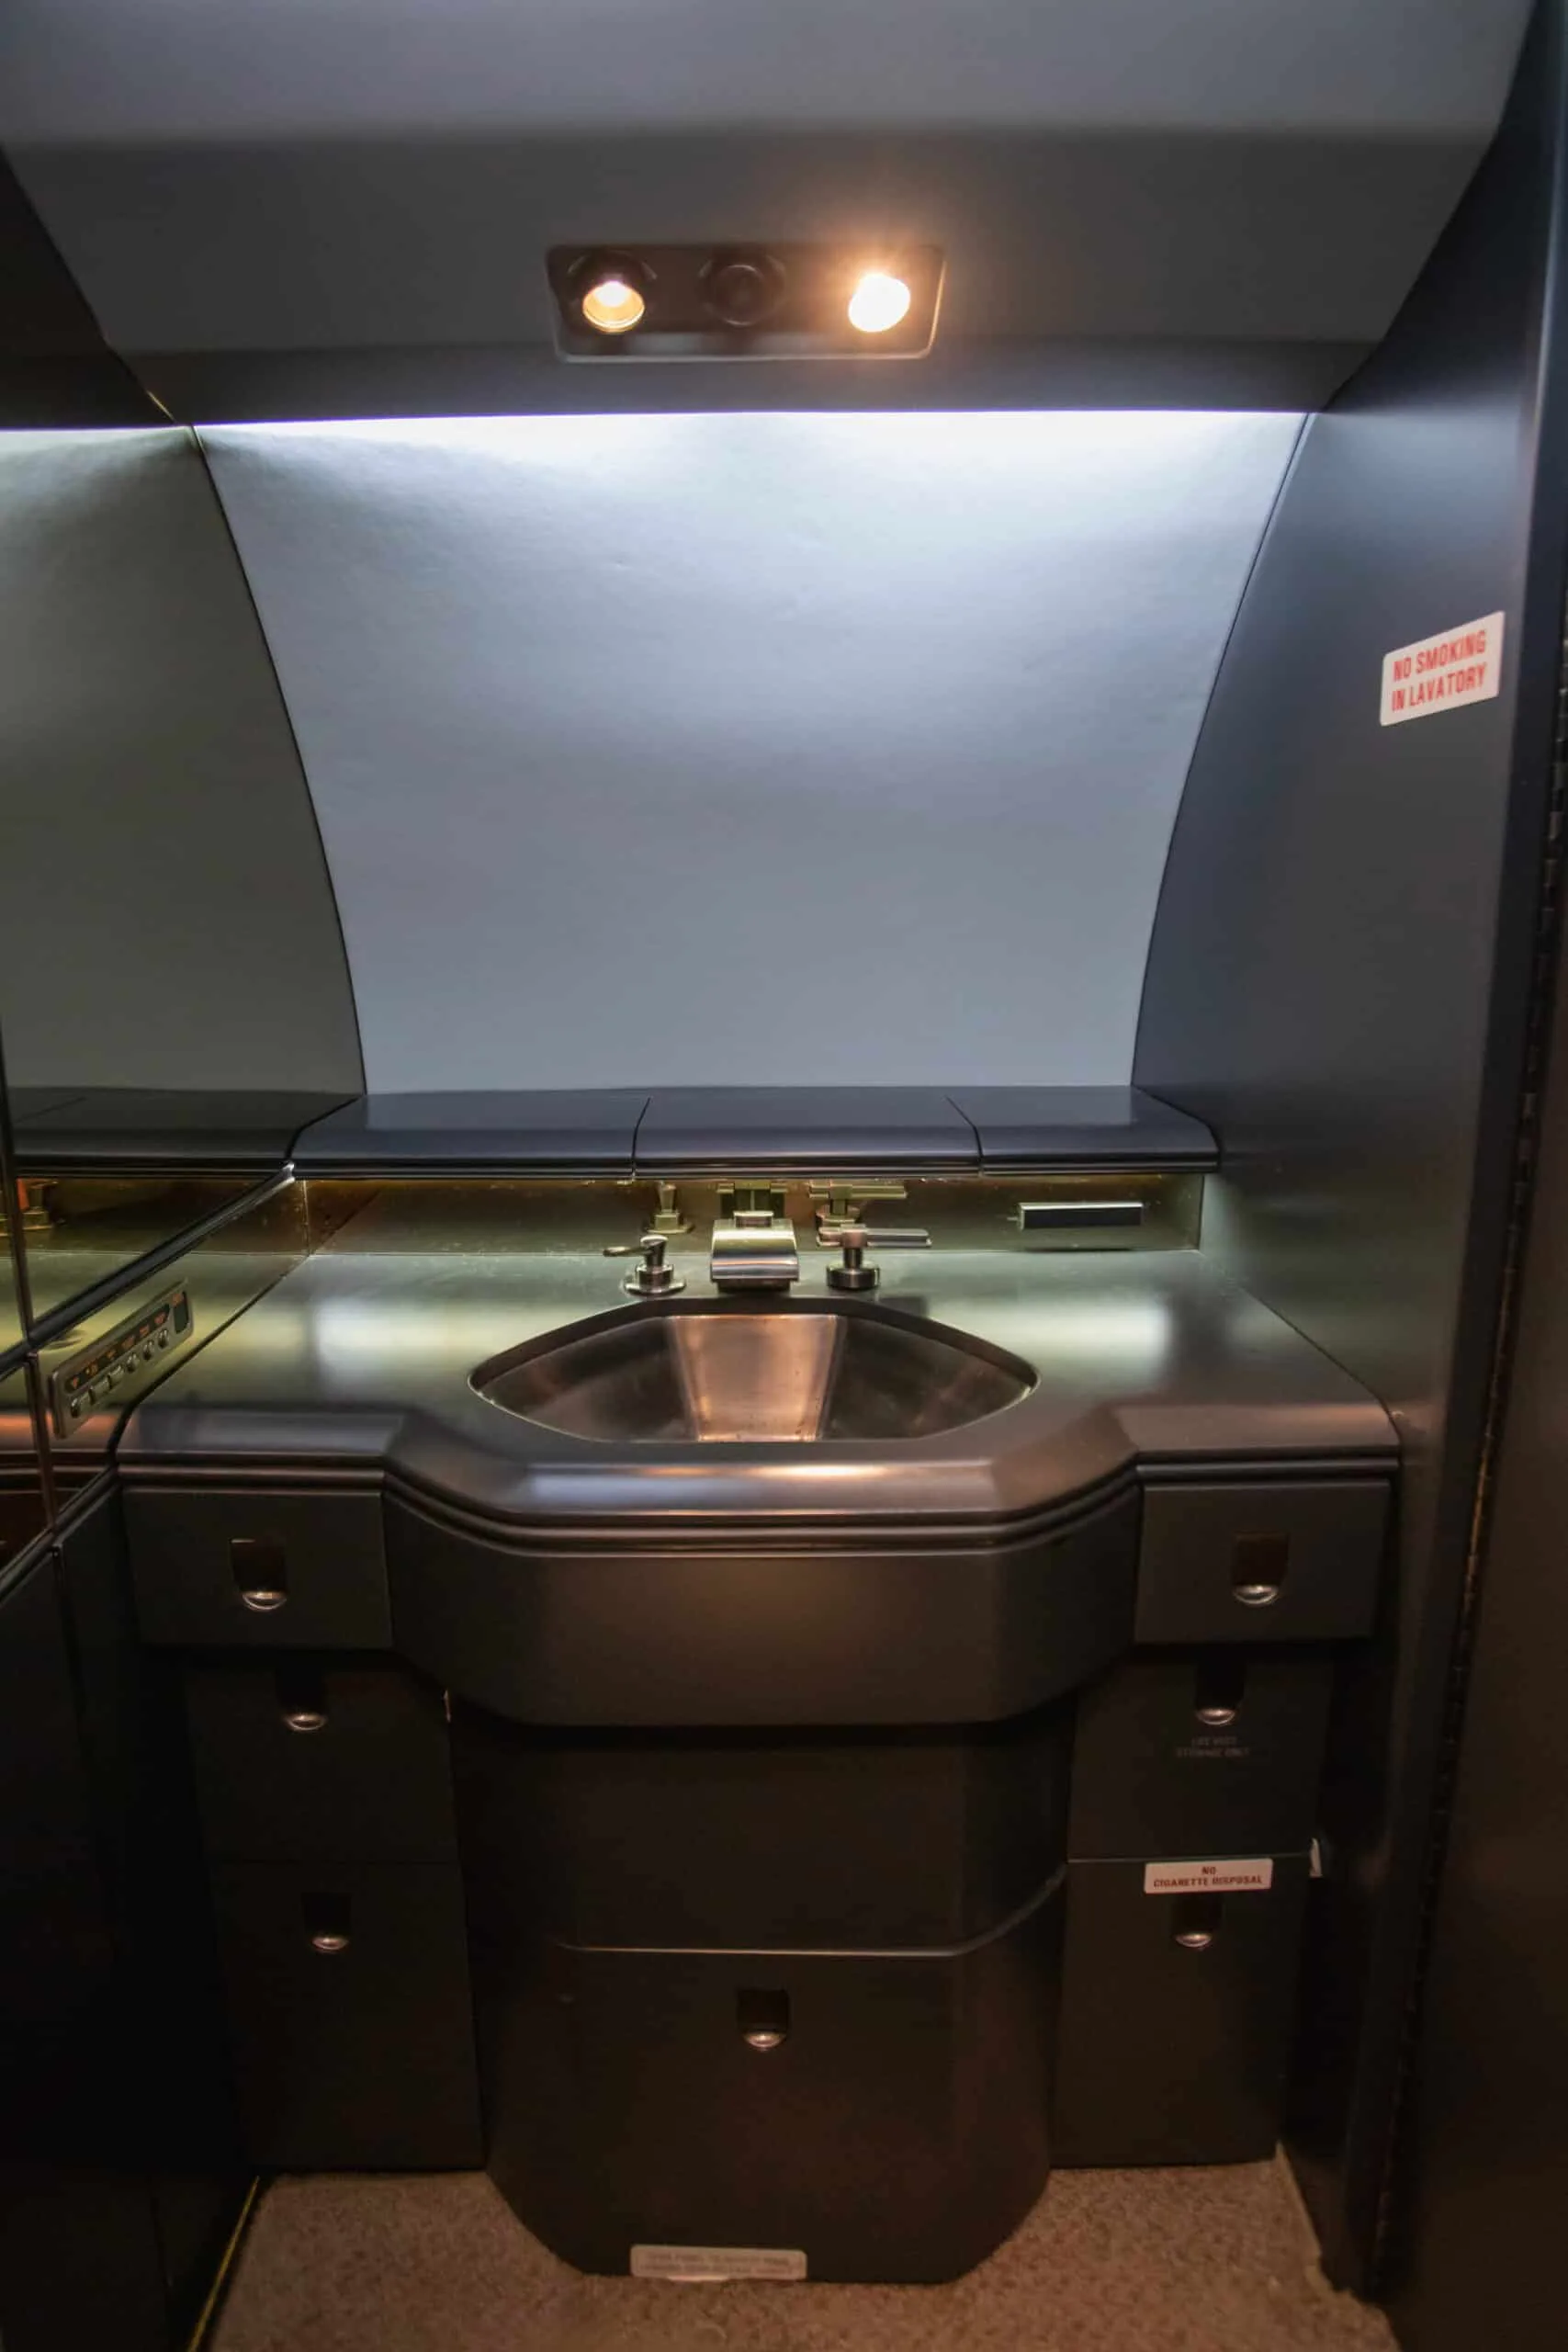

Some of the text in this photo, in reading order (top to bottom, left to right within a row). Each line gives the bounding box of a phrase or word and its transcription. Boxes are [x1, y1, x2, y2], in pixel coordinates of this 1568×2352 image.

[1393, 629, 1486, 682] NO SMOKING
[1392, 662, 1486, 711] IN LAVATORY
[1153, 1878, 1208, 1888] CIGARETTE
[1201, 1866, 1217, 1875] NO
